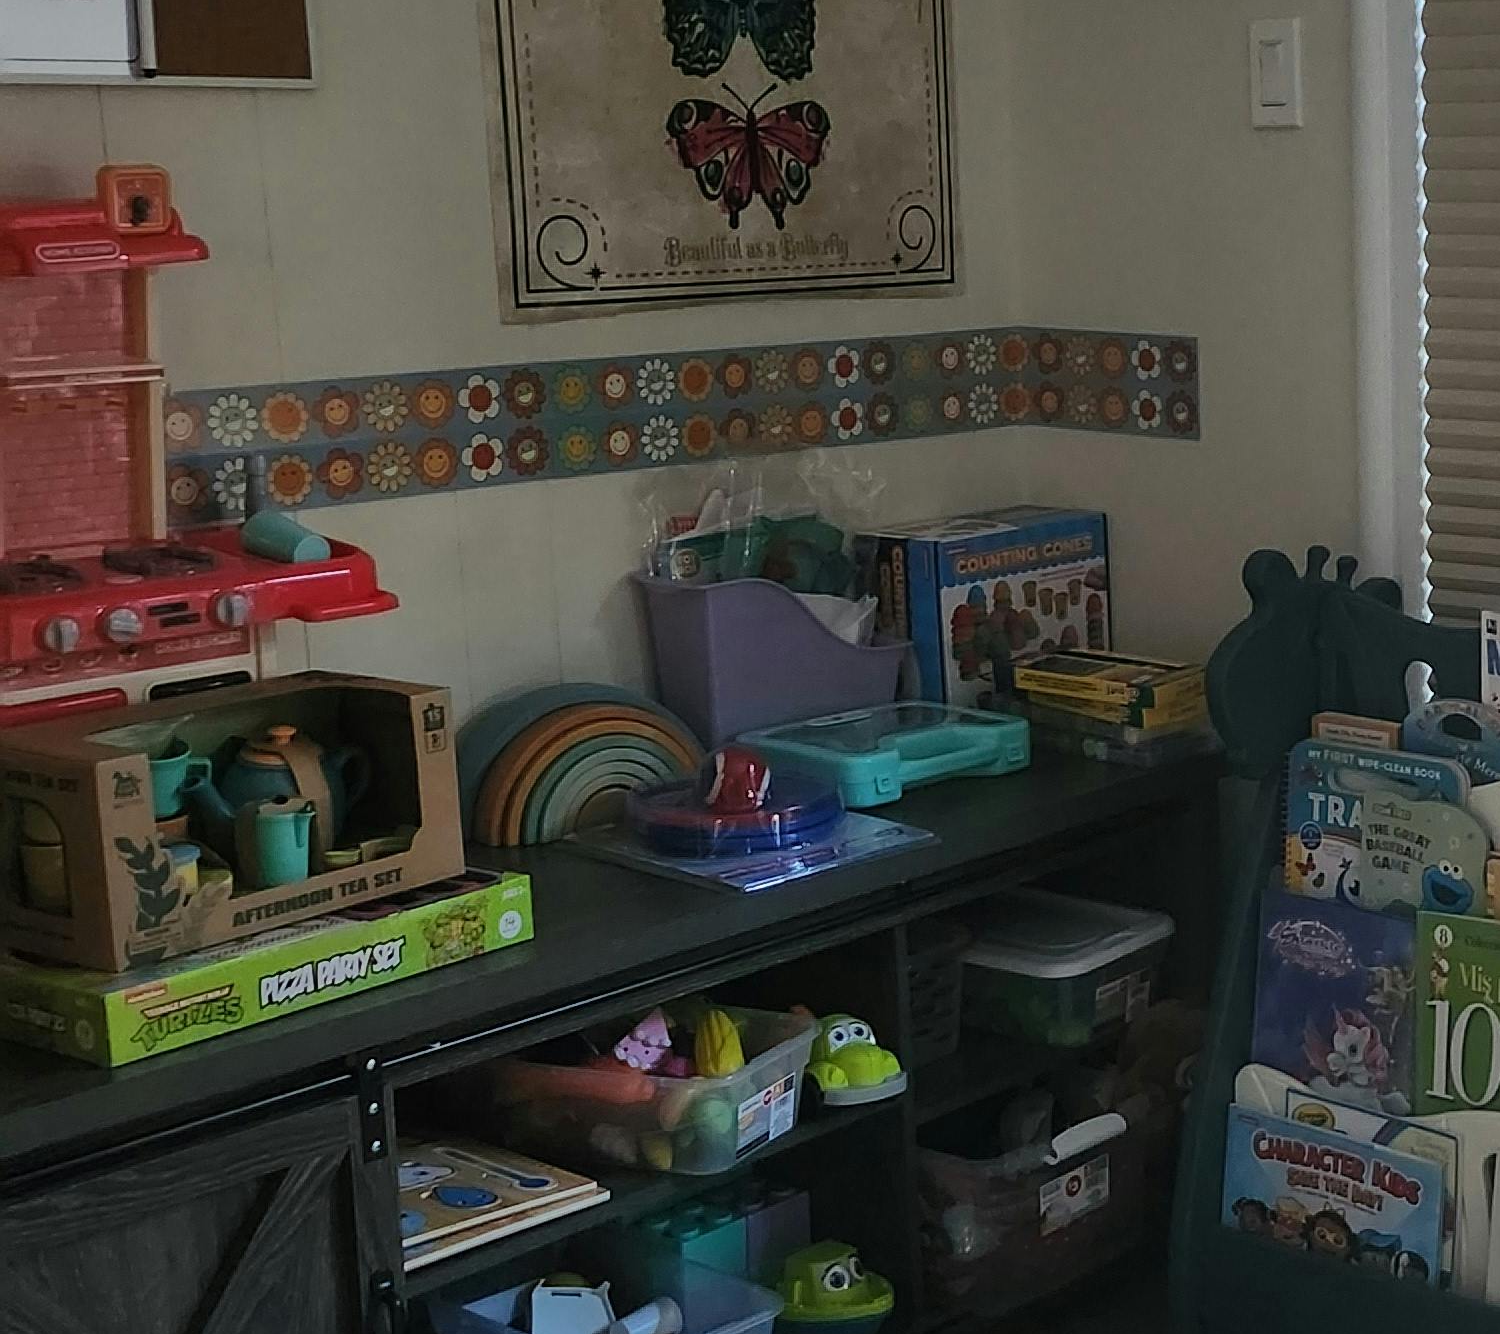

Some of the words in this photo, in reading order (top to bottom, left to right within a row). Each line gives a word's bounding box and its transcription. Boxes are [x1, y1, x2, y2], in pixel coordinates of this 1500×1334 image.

[664, 237, 742, 267] Beautiful
[780, 233, 849, 261] Butterfly
[957, 545, 1038, 575] COUNTING
[1043, 536, 1093, 557] CONES
[1308, 748, 1322, 760] MY
[1323, 749, 1355, 765] FIRST
[1357, 757, 1411, 776] WIPE-CLEAN
[1413, 766, 1441, 781] BOOK
[1366, 838, 1425, 864] BASEBALL
[1367, 823, 1389, 836] THE
[1393, 827, 1432, 850] GREAT
[1372, 855, 1410, 875] GAME
[233, 887, 333, 928] AFTERNOON
[340, 878, 368, 897] TEA
[374, 867, 402, 888] SET
[1438, 928, 1448, 946] 8
[260, 963, 315, 1008] PIZZA
[317, 946, 373, 990] PARTY
[372, 936, 405, 973] SET
[1459, 962, 1495, 1004] Mis
[130, 995, 243, 1051] TURTLES
[1253, 1129, 1366, 1183] CHARACTER
[1371, 1158, 1423, 1206] KIDS
[1287, 1167, 1320, 1190] SAVE
[1323, 1176, 1350, 1198] THE
